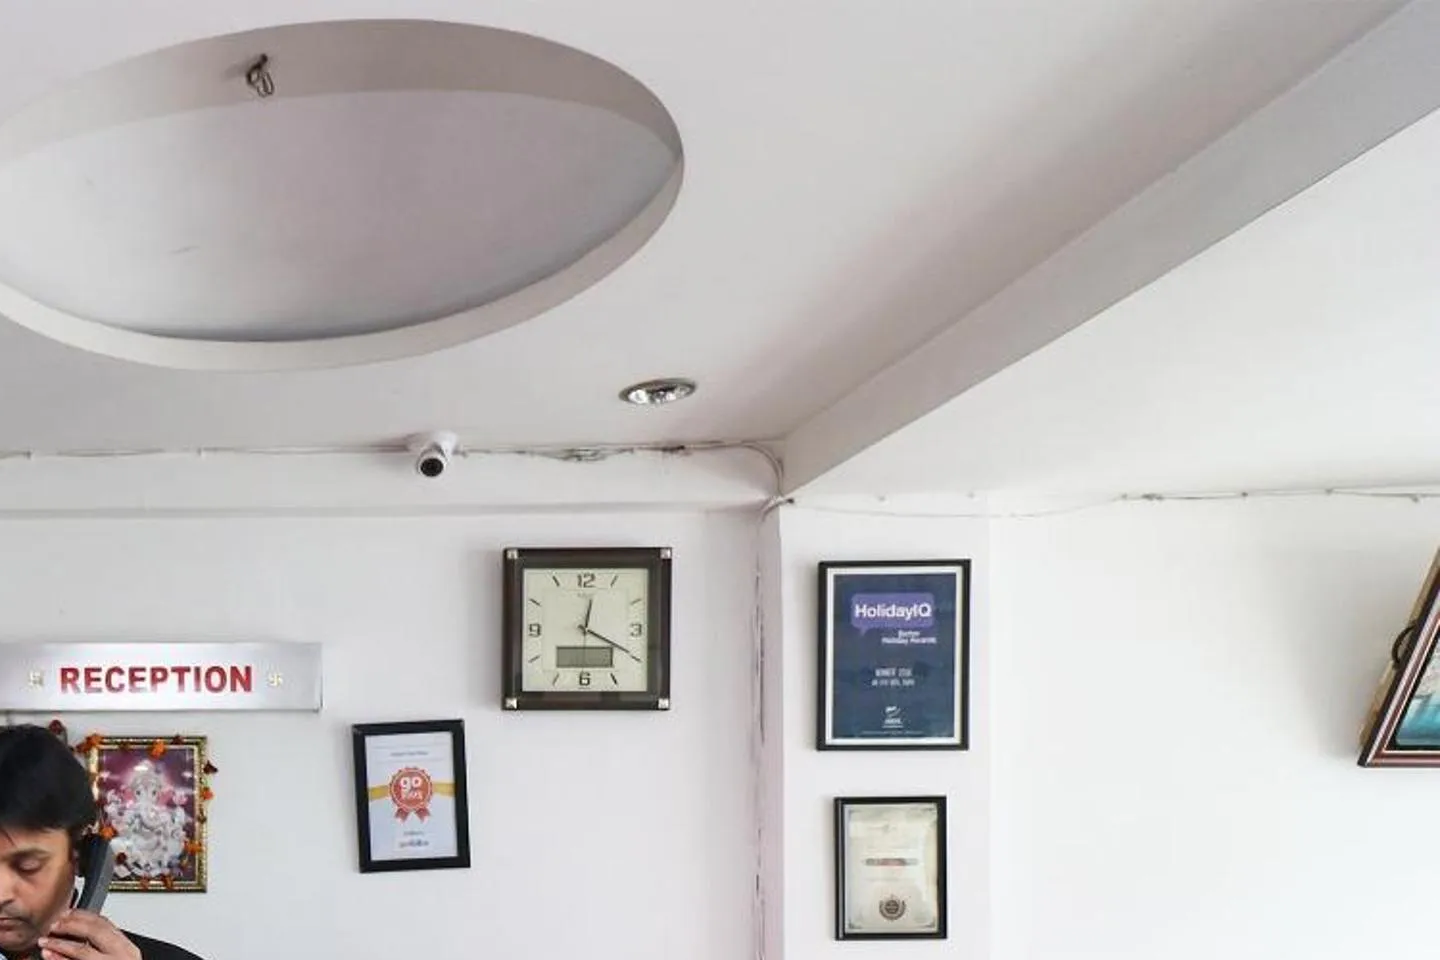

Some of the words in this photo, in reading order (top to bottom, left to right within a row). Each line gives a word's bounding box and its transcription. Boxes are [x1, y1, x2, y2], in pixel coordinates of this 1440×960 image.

[577, 573, 596, 588] 12
[855, 603, 932, 621] HolidayIQ
[528, 623, 542, 637] 9
[630, 623, 643, 637] 3
[60, 666, 252, 693] RECEPTION
[578, 672, 591, 686] 6
